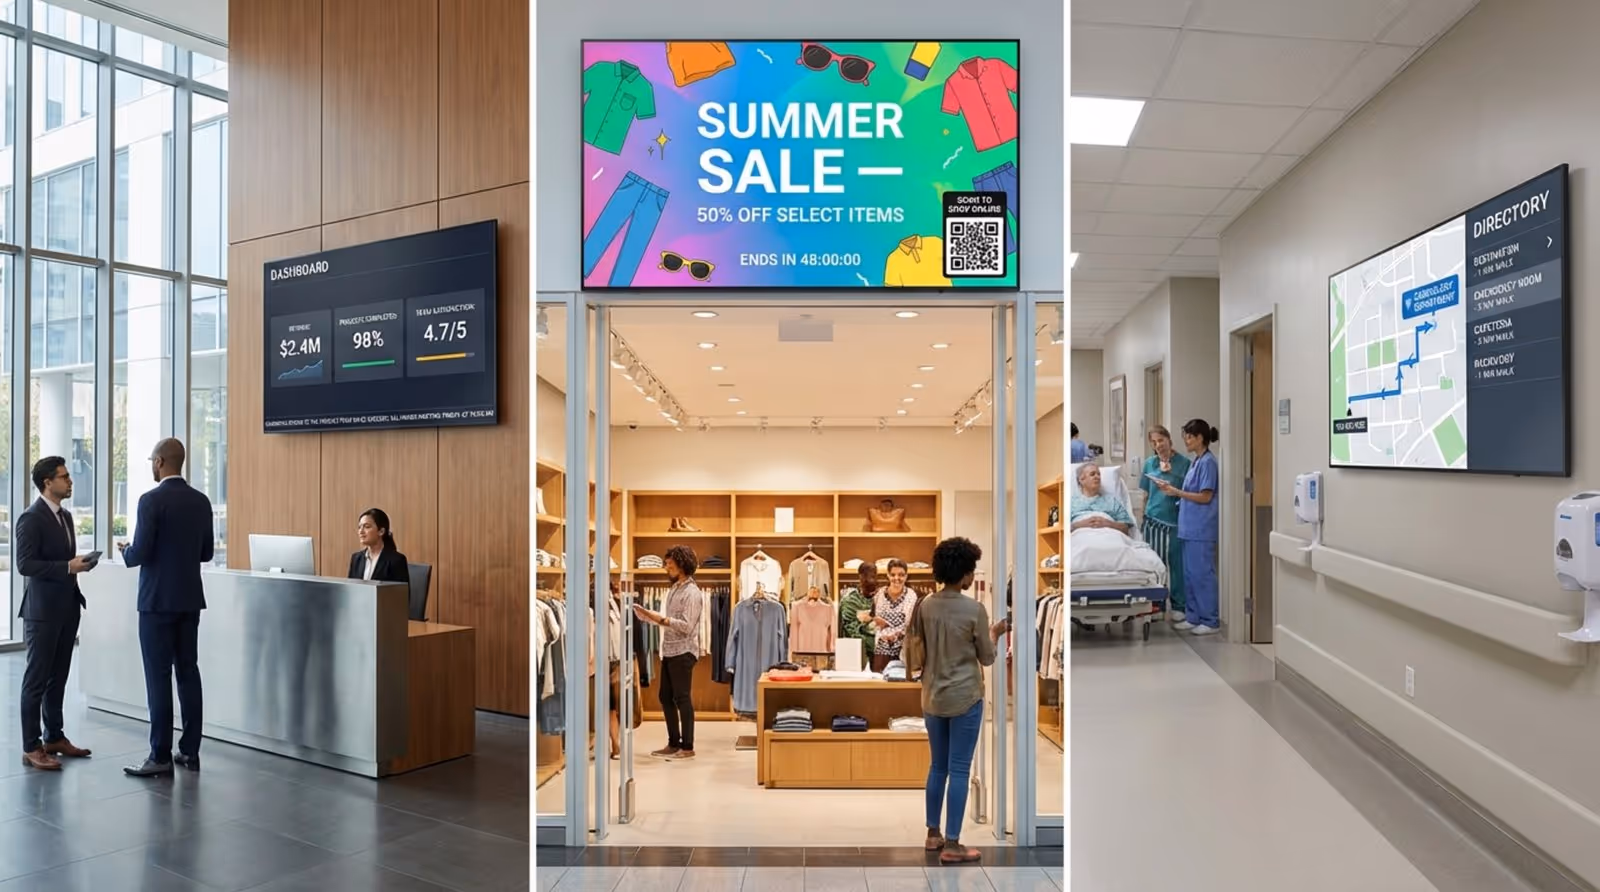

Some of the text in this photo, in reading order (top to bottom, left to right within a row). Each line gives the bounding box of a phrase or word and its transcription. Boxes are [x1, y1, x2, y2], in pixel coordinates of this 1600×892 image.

[697, 102, 904, 139] SUMMER
[697, 148, 845, 194] SALE
[697, 207, 905, 222] 50% OFF SELECT ITEMS
[1473, 189, 1550, 239] DIRECTORY
[270, 261, 329, 280] DASHBOARD
[740, 253, 861, 266] ENDS IN 48:00:00
[353, 330, 384, 349] 98%
[423, 320, 467, 342] 4.7/5
[279, 336, 320, 358] $2.4M
